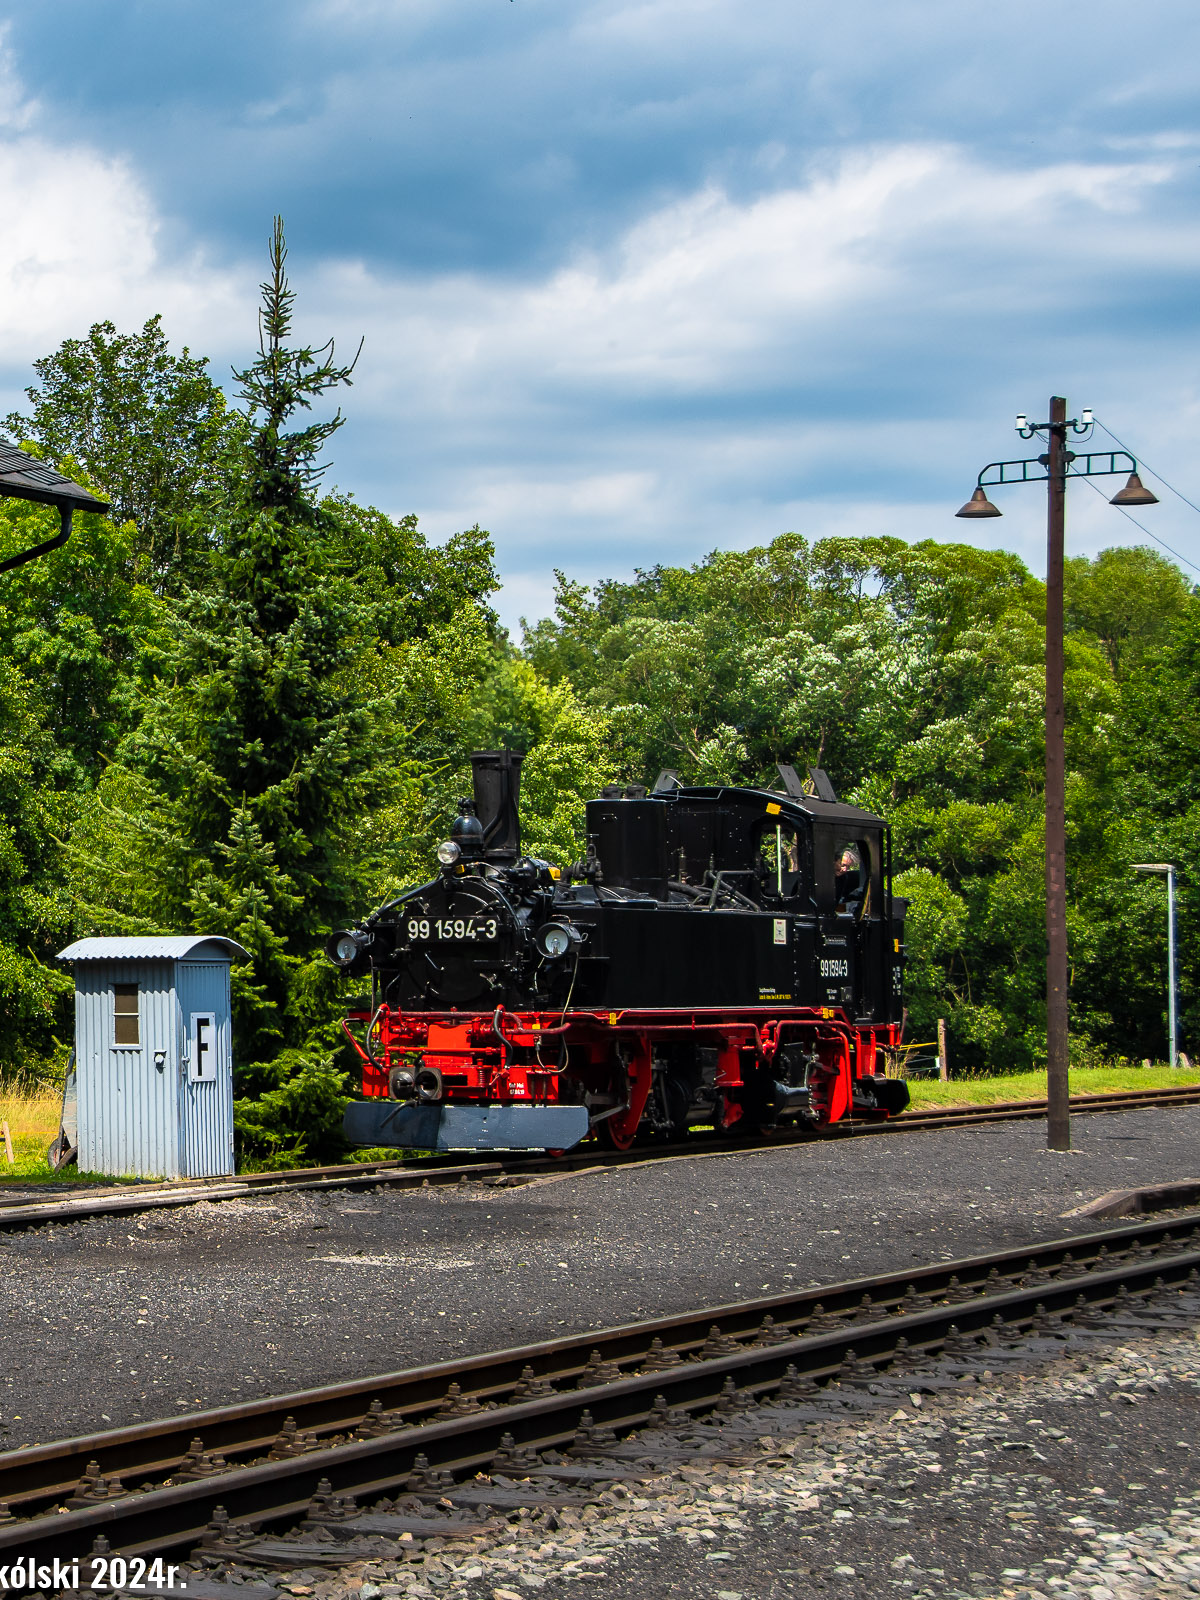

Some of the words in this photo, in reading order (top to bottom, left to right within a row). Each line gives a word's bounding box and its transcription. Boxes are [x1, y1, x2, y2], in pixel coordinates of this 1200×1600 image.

[408, 919, 430, 939] 99
[434, 919, 498, 939] 1594-3
[196, 1017, 210, 1077] F
